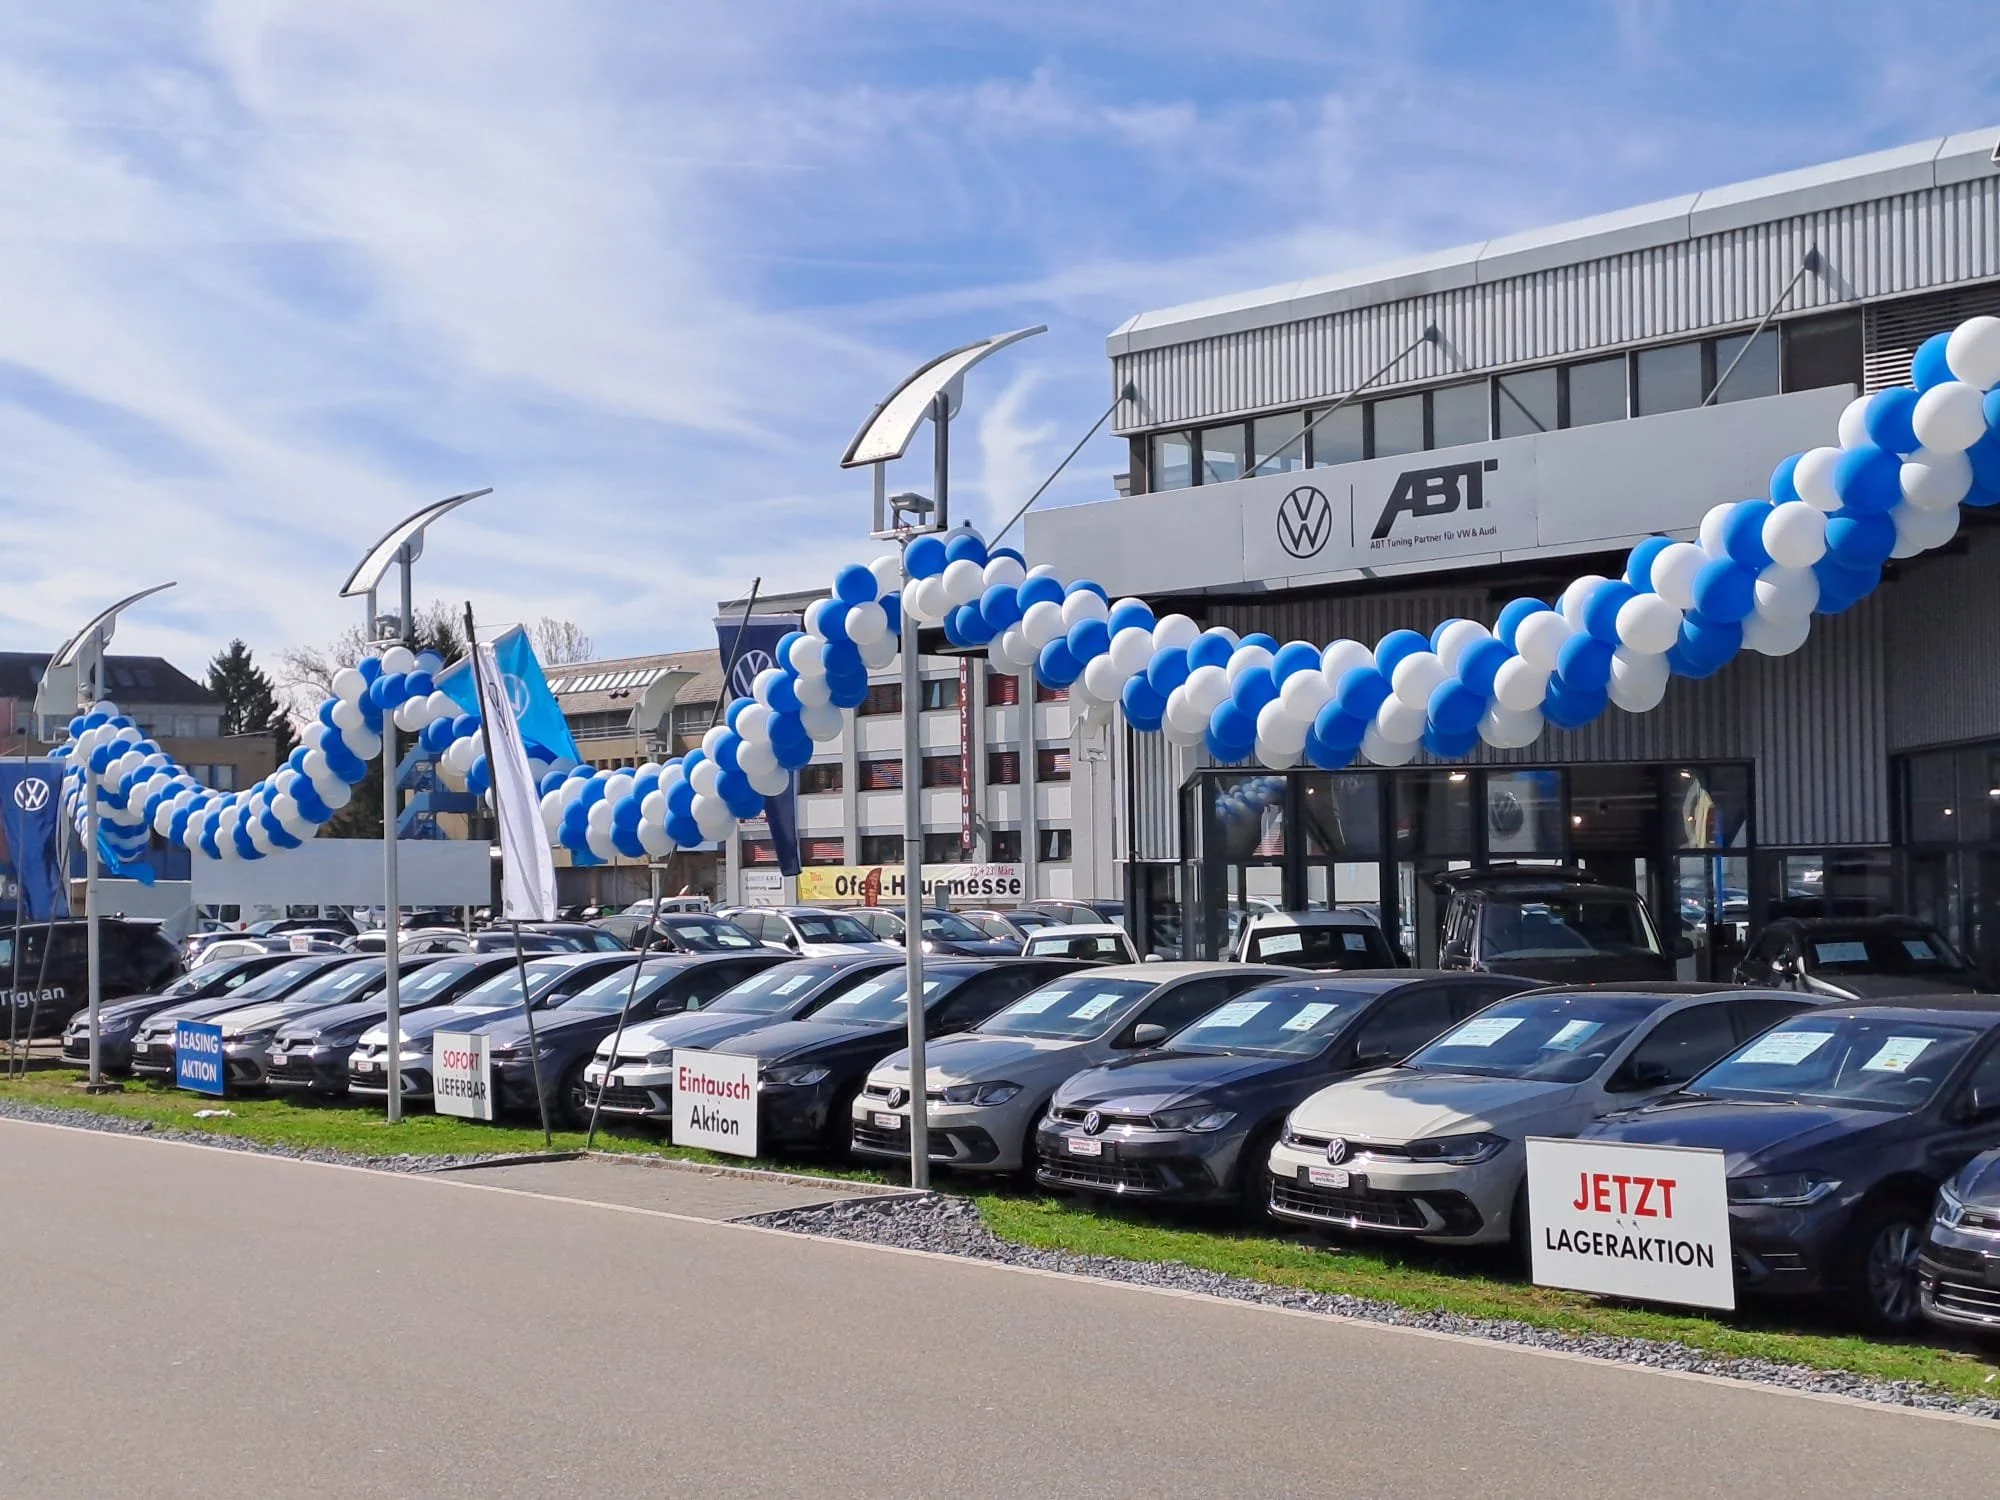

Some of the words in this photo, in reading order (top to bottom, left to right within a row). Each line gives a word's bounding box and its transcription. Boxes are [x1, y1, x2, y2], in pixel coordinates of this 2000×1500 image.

[1371, 459, 1498, 540] ABT
[1370, 540, 1386, 550] ABT
[1387, 538, 1413, 548] Tuning
[1414, 534, 1441, 544] Partner
[1444, 531, 1455, 540] für
[1479, 525, 1497, 536] Audi
[960, 656, 970, 842] AUSSTELLUNG
[835, 875, 1021, 895] Ofe-Humesse
[0, 986, 65, 1008] Tiguan
[179, 1030, 219, 1054] LEASING
[181, 1058, 217, 1082] AKTION
[443, 1050, 480, 1071] SOFORT
[437, 1076, 487, 1100] LIEFERBAR
[679, 1066, 750, 1100] Eintausch
[690, 1104, 739, 1136] Aktion
[1573, 1172, 1677, 1219] JETZT
[1545, 1227, 1714, 1268] LAGERAKTION
